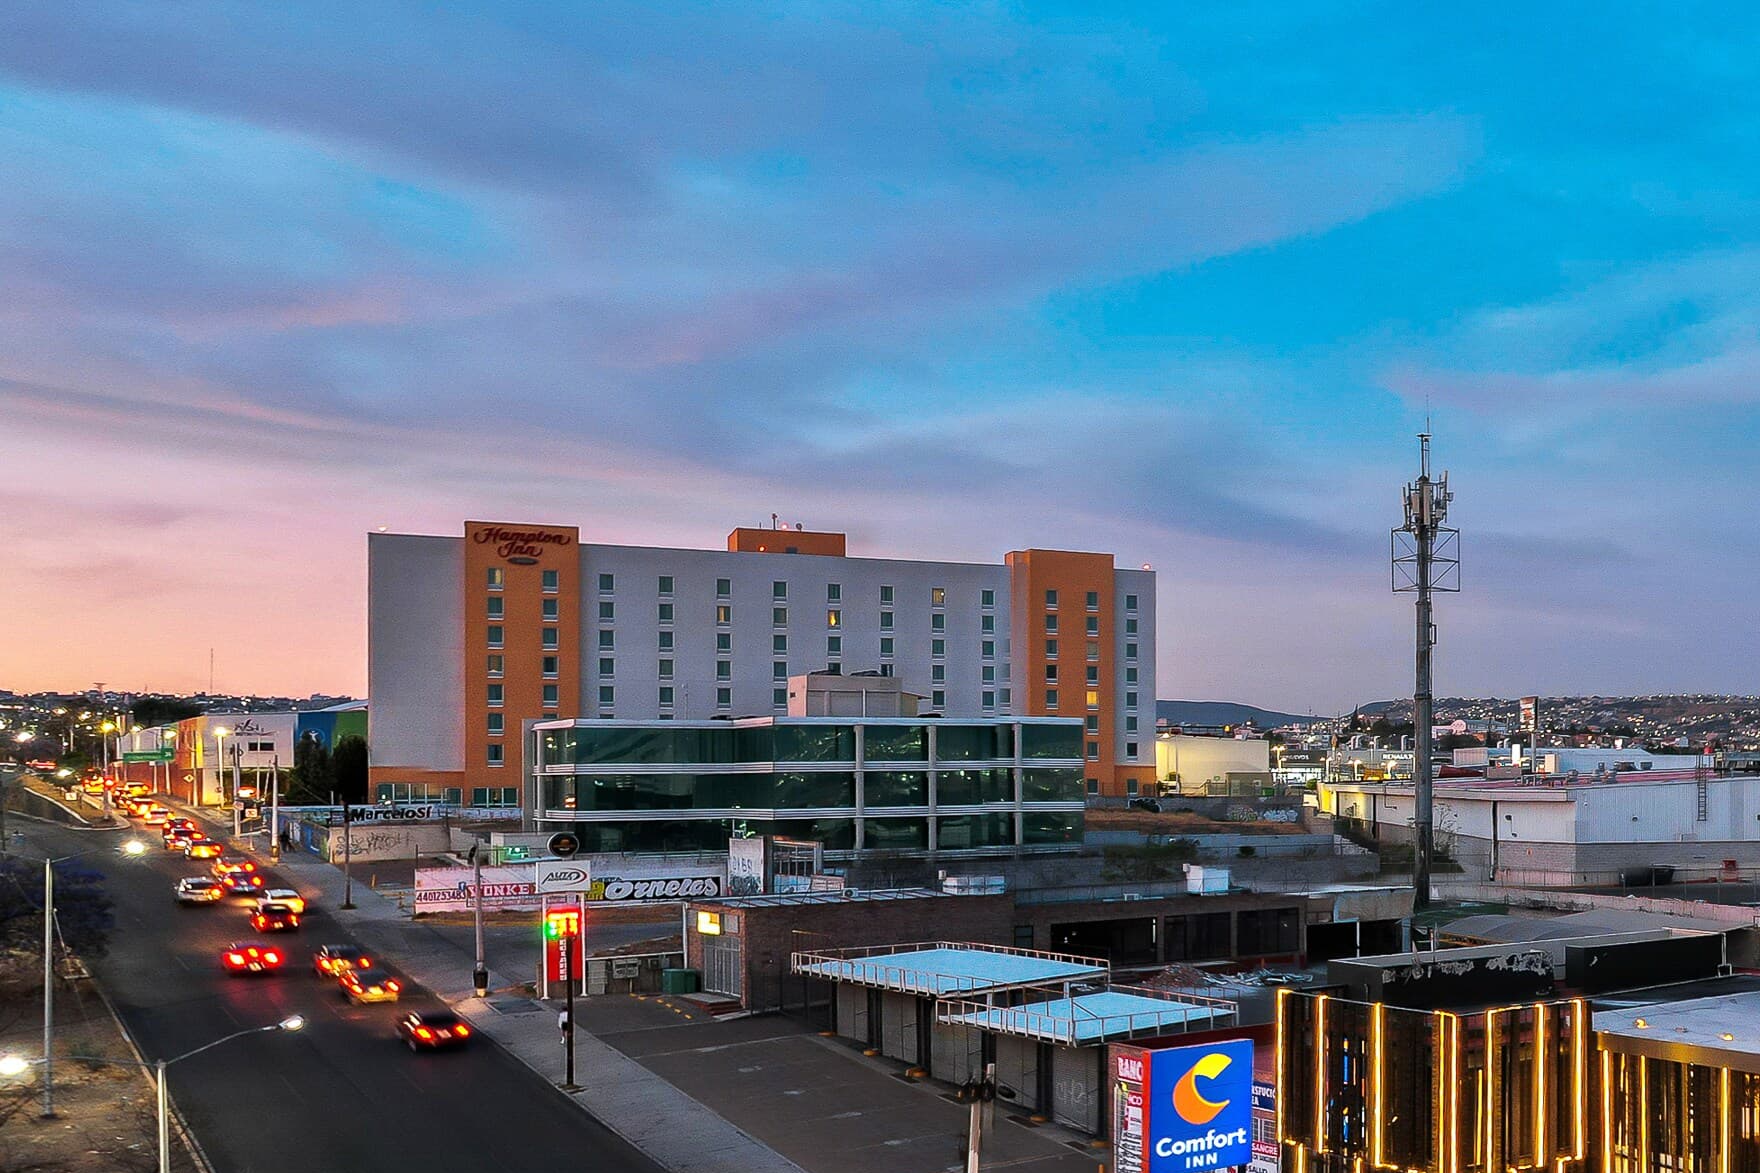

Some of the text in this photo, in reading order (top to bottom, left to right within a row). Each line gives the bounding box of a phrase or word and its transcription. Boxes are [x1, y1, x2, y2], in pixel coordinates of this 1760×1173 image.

[474, 527, 571, 546] Hampton
[497, 541, 543, 558] Inn
[1156, 1127, 1247, 1157] Comfort
[1186, 1152, 1218, 1169] INN
